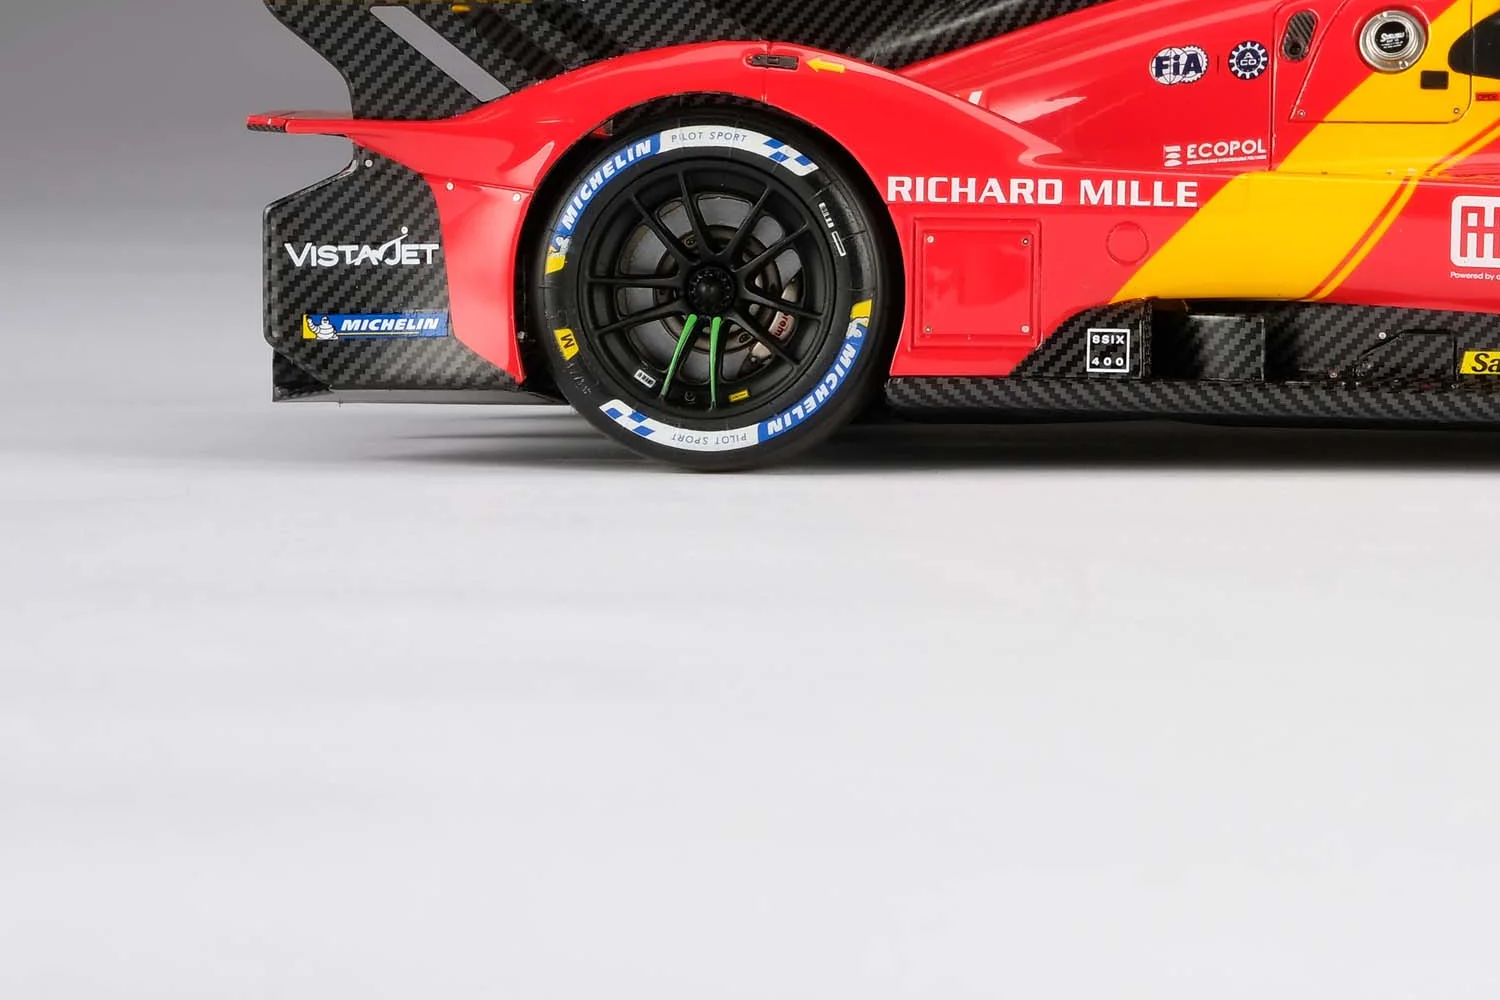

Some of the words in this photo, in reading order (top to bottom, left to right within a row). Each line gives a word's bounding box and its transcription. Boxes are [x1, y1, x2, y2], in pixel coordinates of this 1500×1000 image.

[671, 131, 702, 143] PILOT
[710, 131, 748, 143] SPORT
[1186, 138, 1267, 159] ECOPOL
[562, 139, 651, 231] MICHELIN
[887, 176, 1063, 205] RICHARD
[1079, 179, 1198, 207] MILLE
[1450, 271, 1484, 280] Powered
[341, 318, 439, 331] MICHELIN
[560, 334, 575, 349] M
[1092, 335, 1125, 345] 8SIX
[1091, 357, 1124, 367] 400
[767, 343, 856, 436] MICHELIN
[671, 432, 709, 445] SPORT
[714, 432, 747, 444] PILOT
